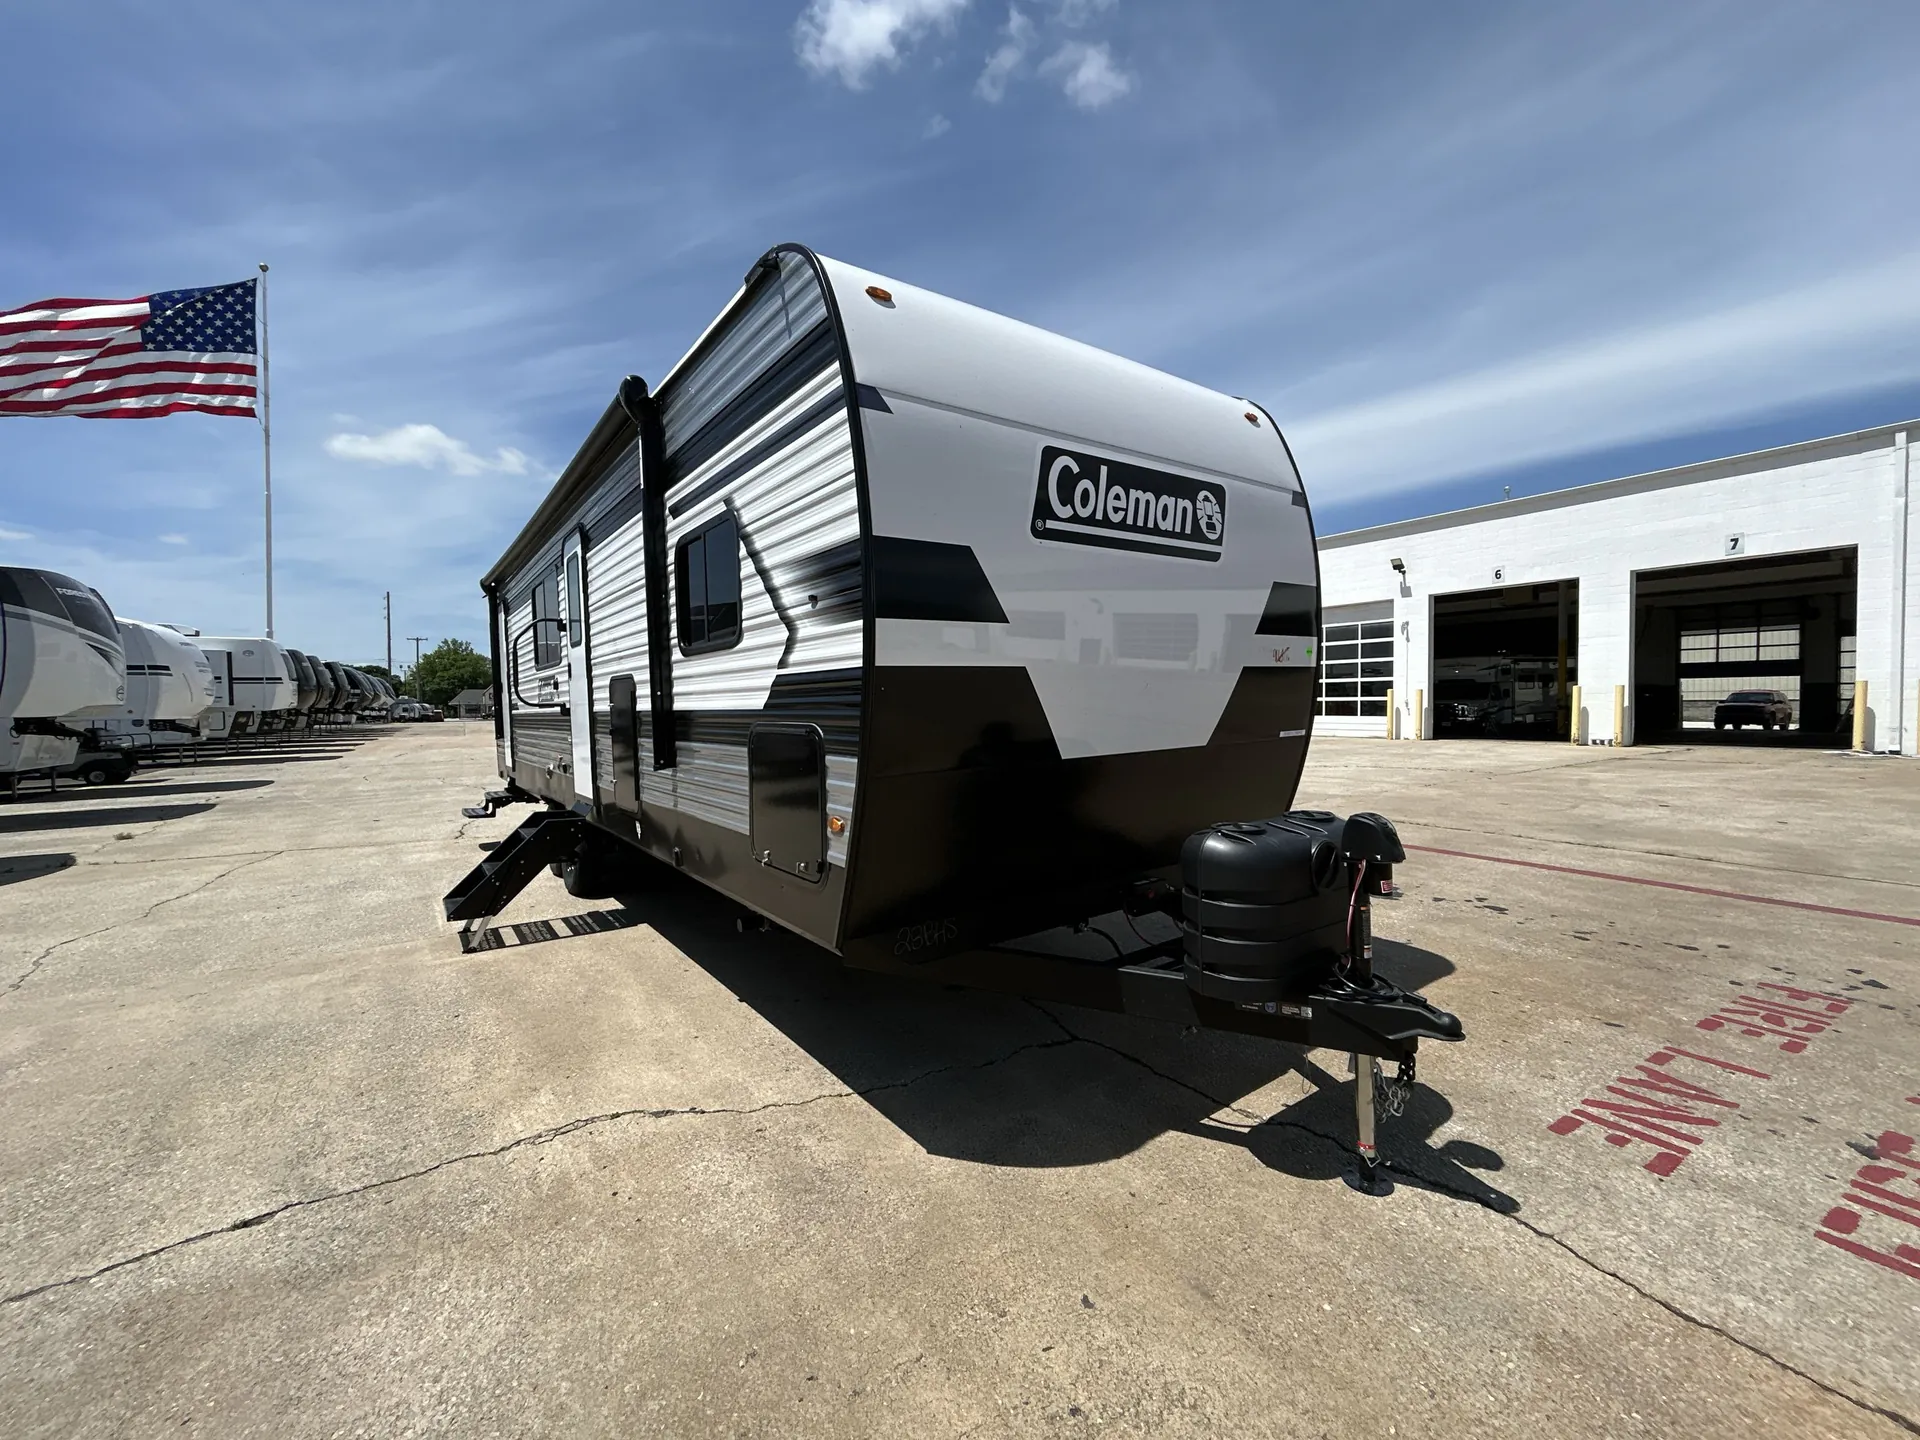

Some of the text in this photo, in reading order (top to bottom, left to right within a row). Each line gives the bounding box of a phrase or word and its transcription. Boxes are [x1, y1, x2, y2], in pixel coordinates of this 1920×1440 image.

[1048, 455, 1193, 534] Coleman
[1730, 537, 1740, 551] 7
[1495, 569, 1502, 580] 6
[1547, 1045, 1773, 1177] LANE
